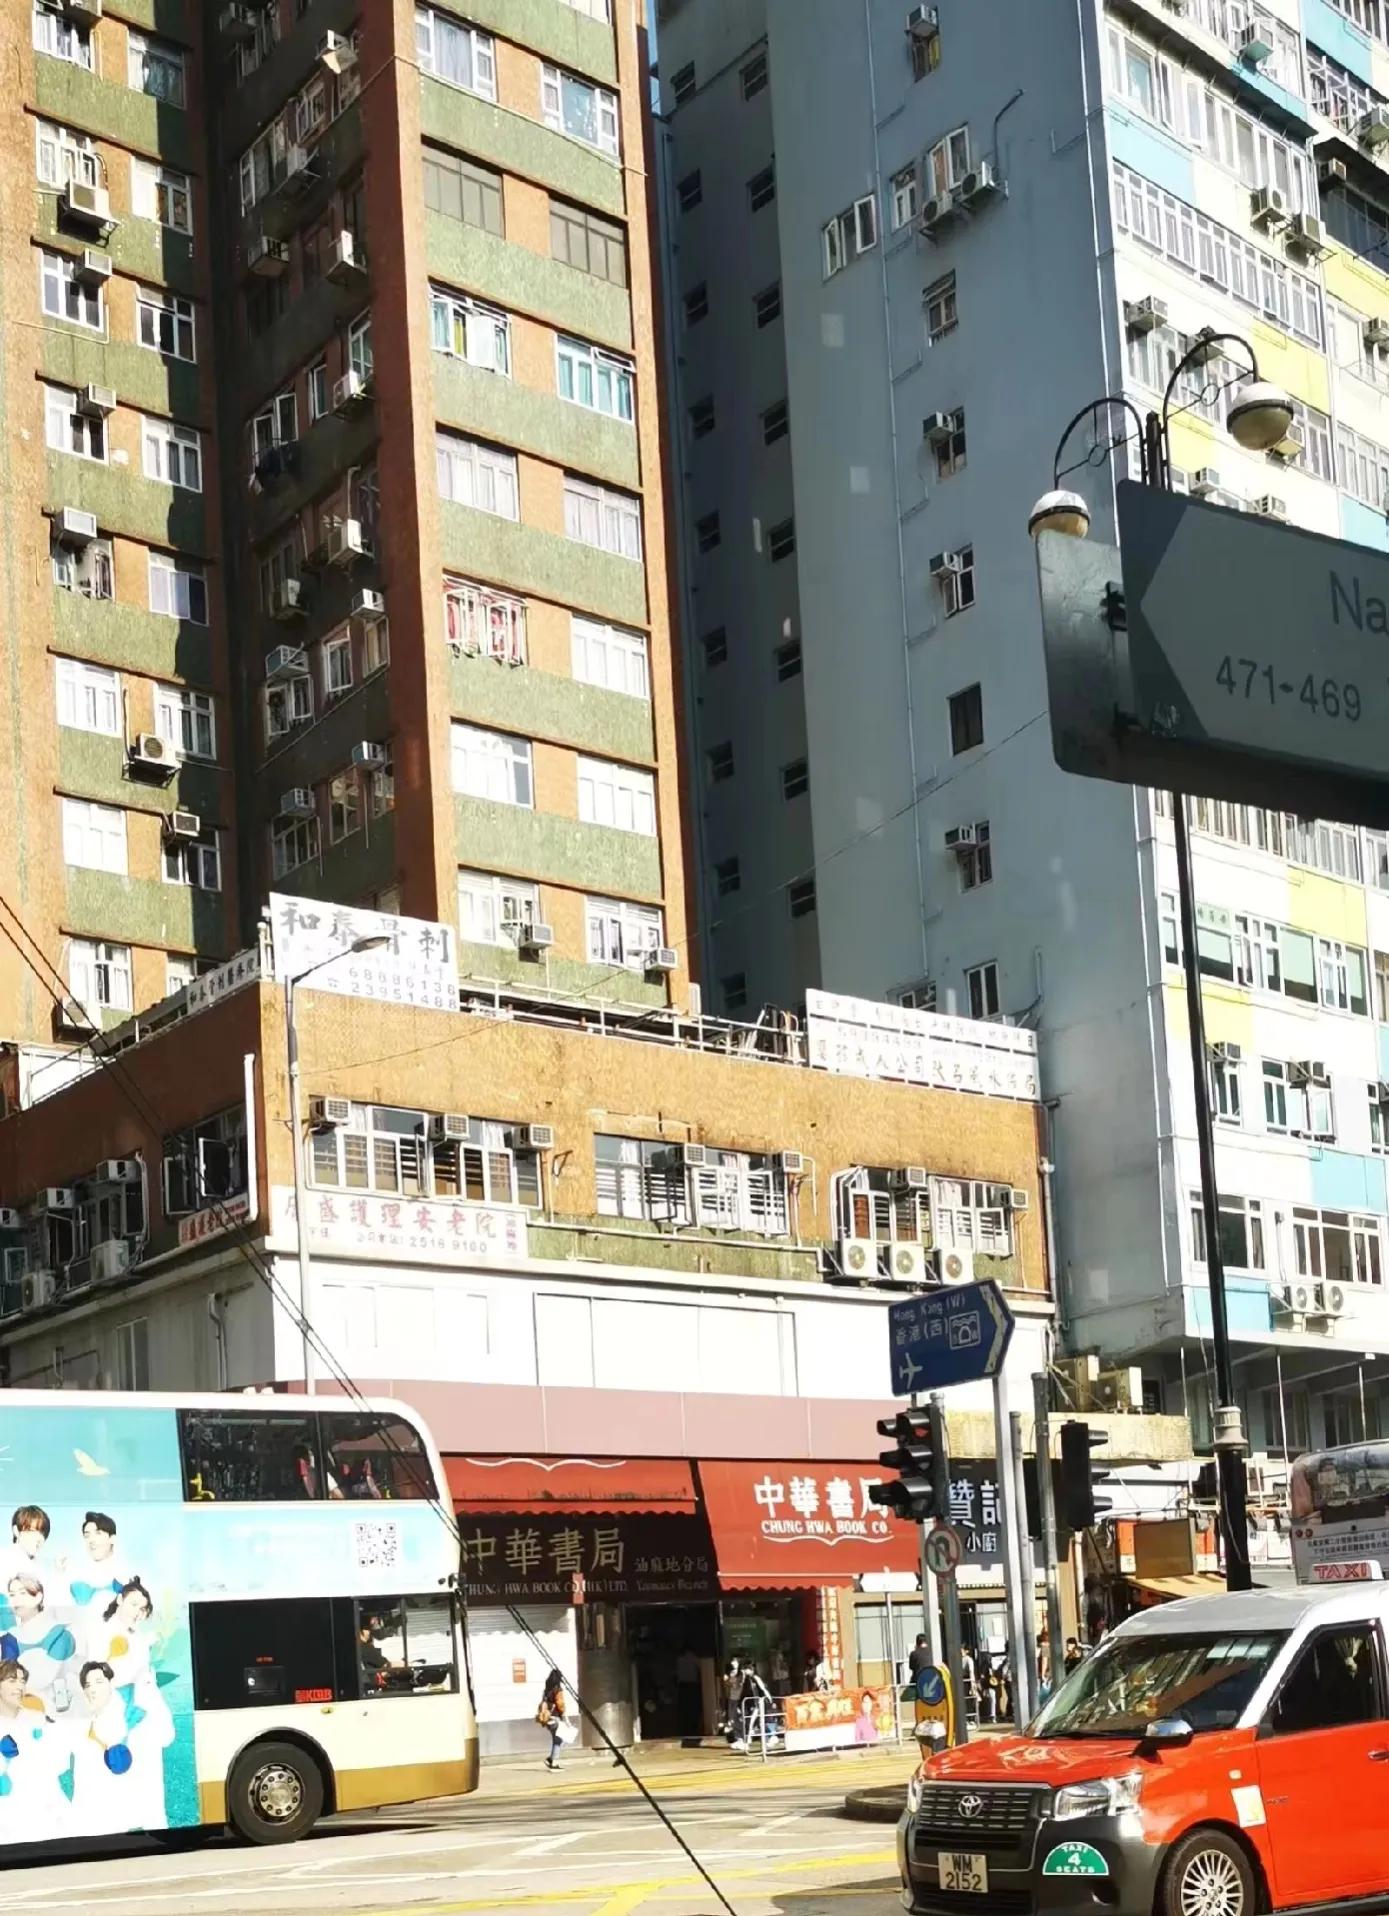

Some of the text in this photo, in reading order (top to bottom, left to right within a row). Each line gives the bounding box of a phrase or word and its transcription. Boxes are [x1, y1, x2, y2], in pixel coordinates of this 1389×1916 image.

[1216, 655, 1361, 722] 471-469
[893, 1292, 966, 1322] Hong Kong (W)
[896, 1317, 949, 1345] 香港(西)
[761, 1519, 893, 1534] CHUNG HWA BOOK CO.
[462, 1527, 625, 1577] 中華書局
[1313, 1562, 1368, 1579] TAXI
[532, 1581, 560, 1594] BOOK
[1060, 1844, 1089, 1854] TAXI
[951, 1854, 973, 1873] WM
[1067, 1852, 1082, 1866] 4
[1055, 1865, 1096, 1873] SEATS
[945, 1872, 983, 1891] 2152
